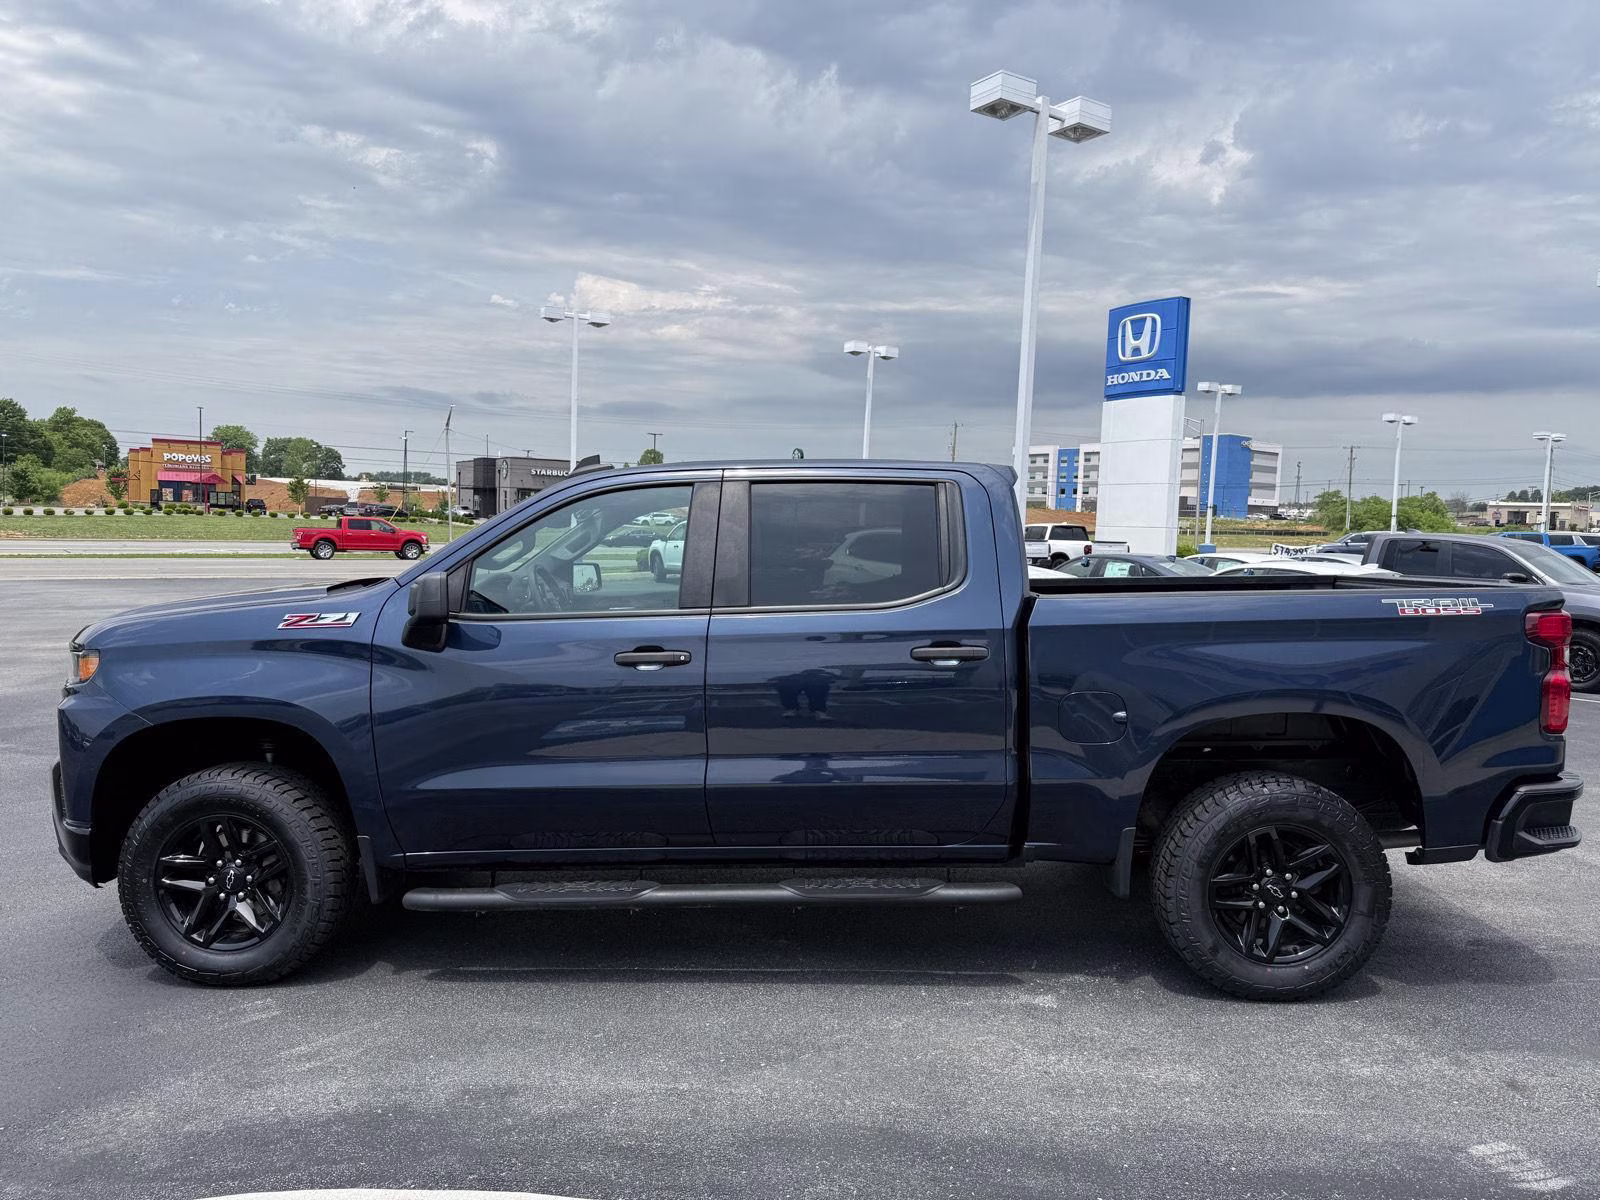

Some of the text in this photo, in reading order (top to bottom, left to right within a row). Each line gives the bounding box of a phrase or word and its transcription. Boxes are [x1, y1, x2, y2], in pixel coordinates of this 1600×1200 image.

[1106, 368, 1171, 386] HONDA
[531, 468, 568, 477] STARBUC
[1381, 598, 1494, 607] TRAIL
[1399, 607, 1482, 616] BOSS
[277, 612, 361, 629] Z71
